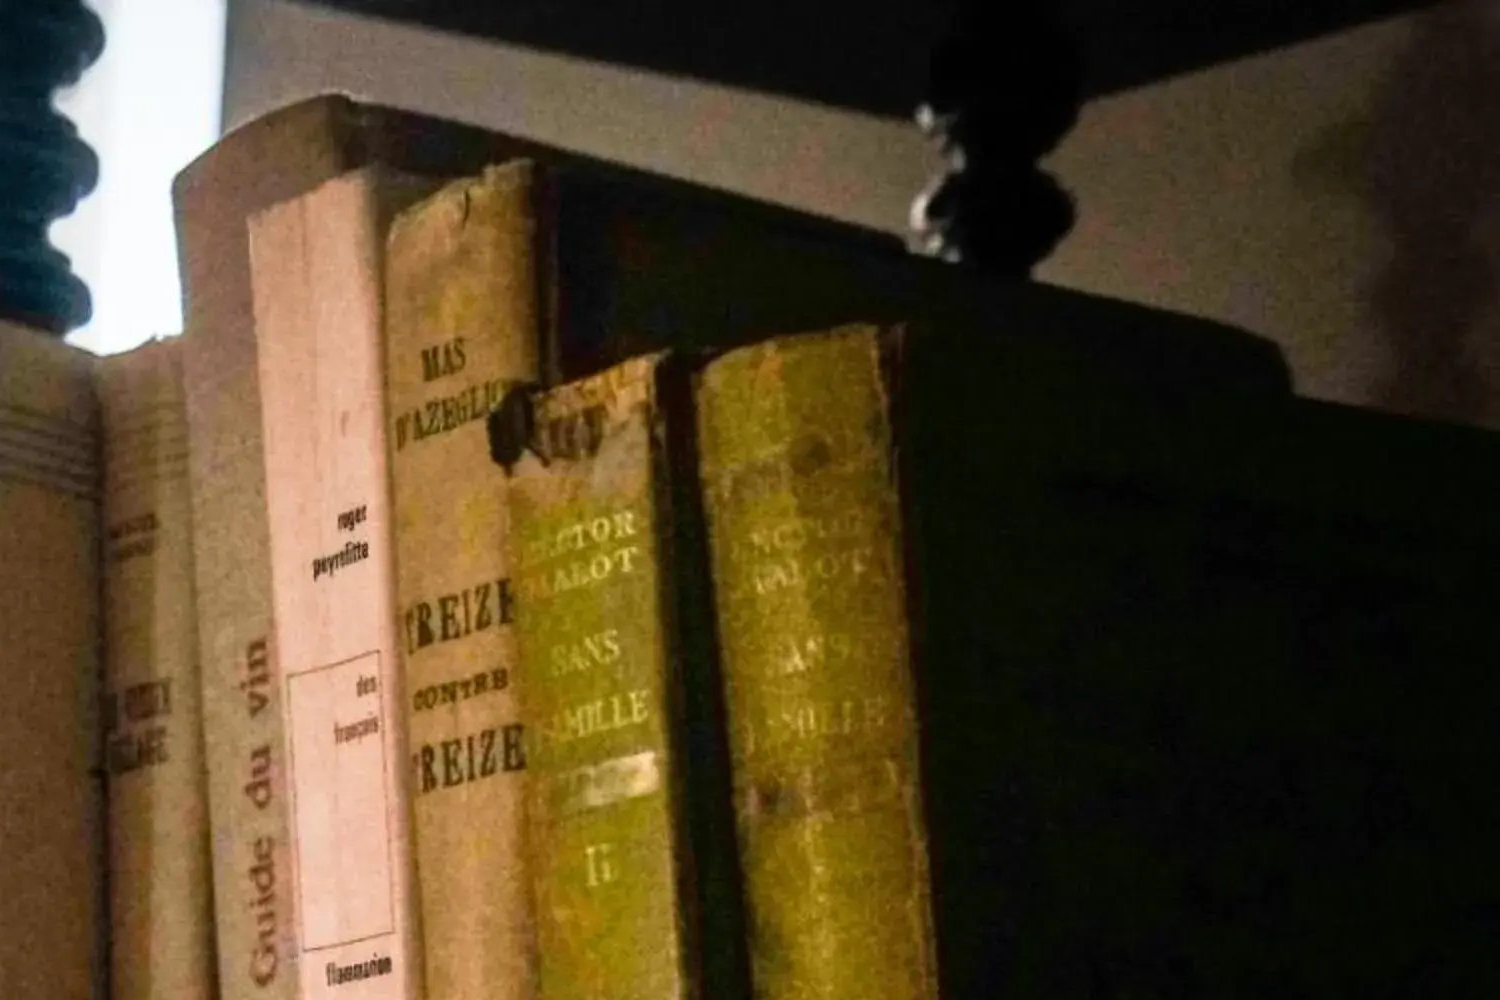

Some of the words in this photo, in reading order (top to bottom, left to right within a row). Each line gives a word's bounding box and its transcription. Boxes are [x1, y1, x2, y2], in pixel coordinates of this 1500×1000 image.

[421, 337, 467, 382] MAS
[337, 505, 368, 532] roger
[312, 541, 370, 582] peyrefitte
[240, 638, 270, 718] vin
[356, 675, 377, 698] des
[412, 667, 509, 712] CONTRE
[245, 745, 272, 810] du
[411, 724, 528, 795] REIZE
[250, 836, 277, 988] Guide
[325, 952, 393, 987] flammarion
